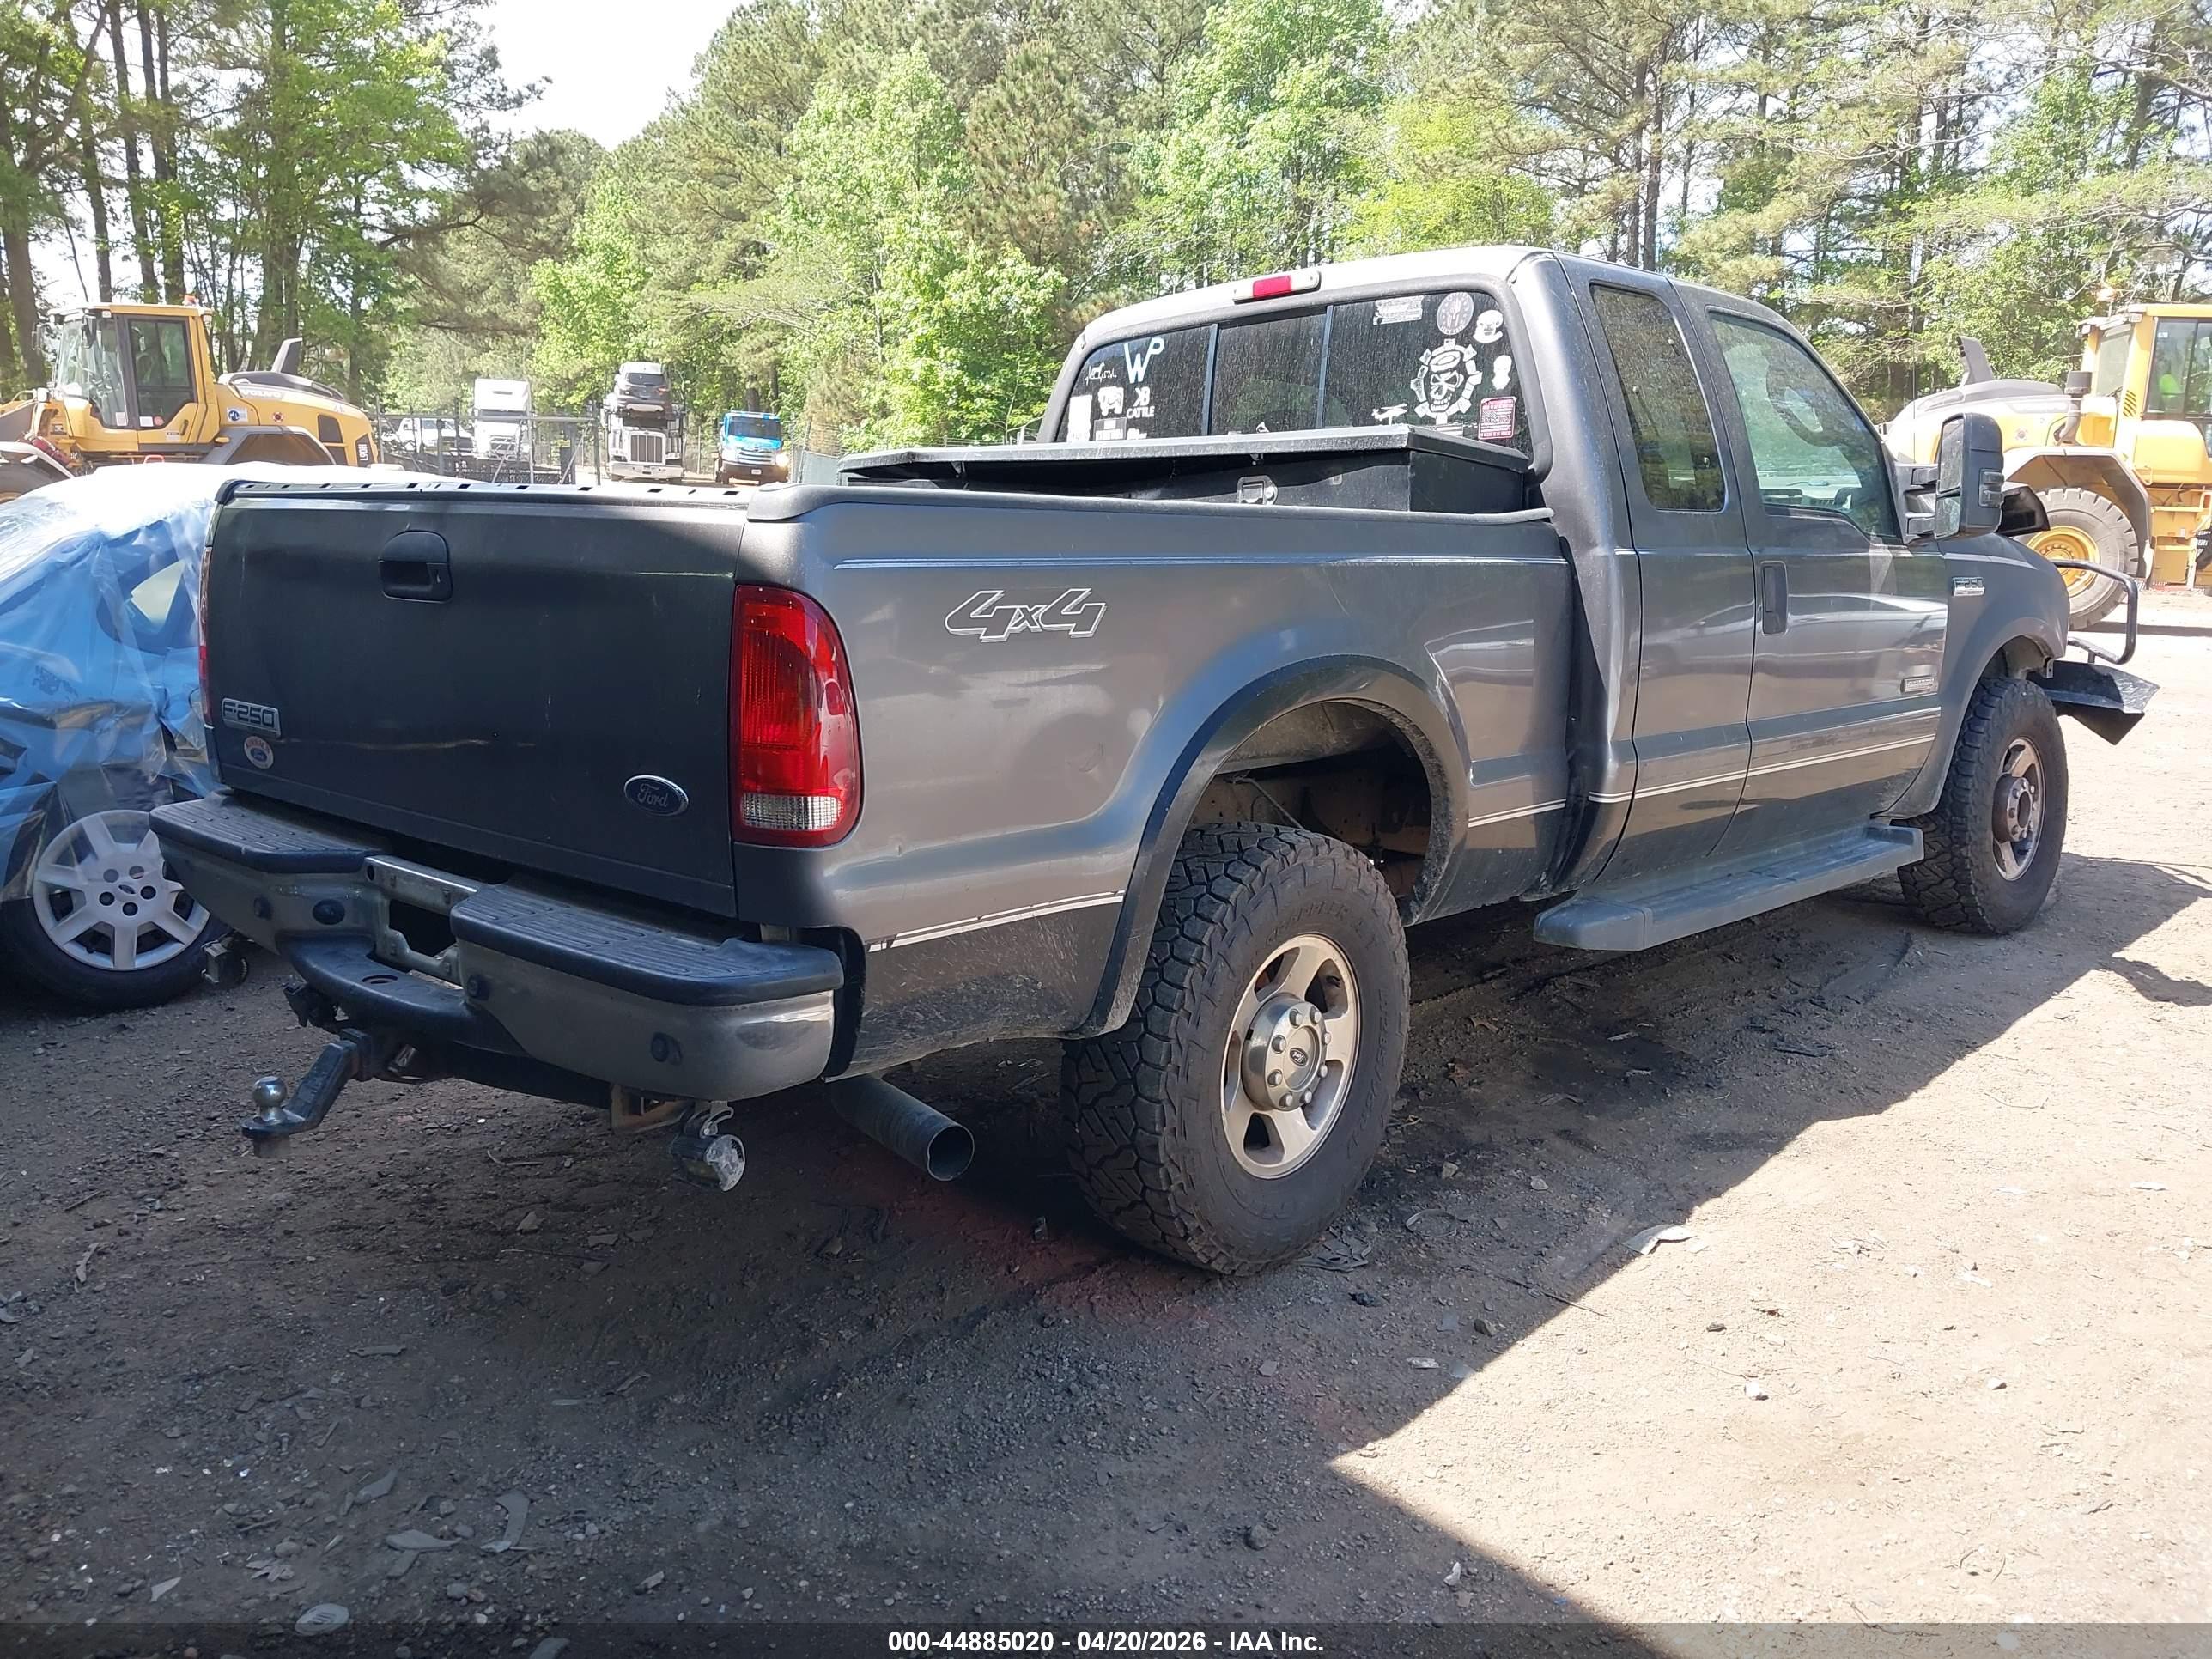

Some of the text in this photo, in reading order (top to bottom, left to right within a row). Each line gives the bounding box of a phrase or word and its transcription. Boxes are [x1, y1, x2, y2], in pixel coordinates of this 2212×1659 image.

[1126, 405, 1155, 419] CATTLE
[358, 443, 369, 462] L90H
[945, 588, 1106, 642] 4x4
[637, 783, 669, 807] Ford
